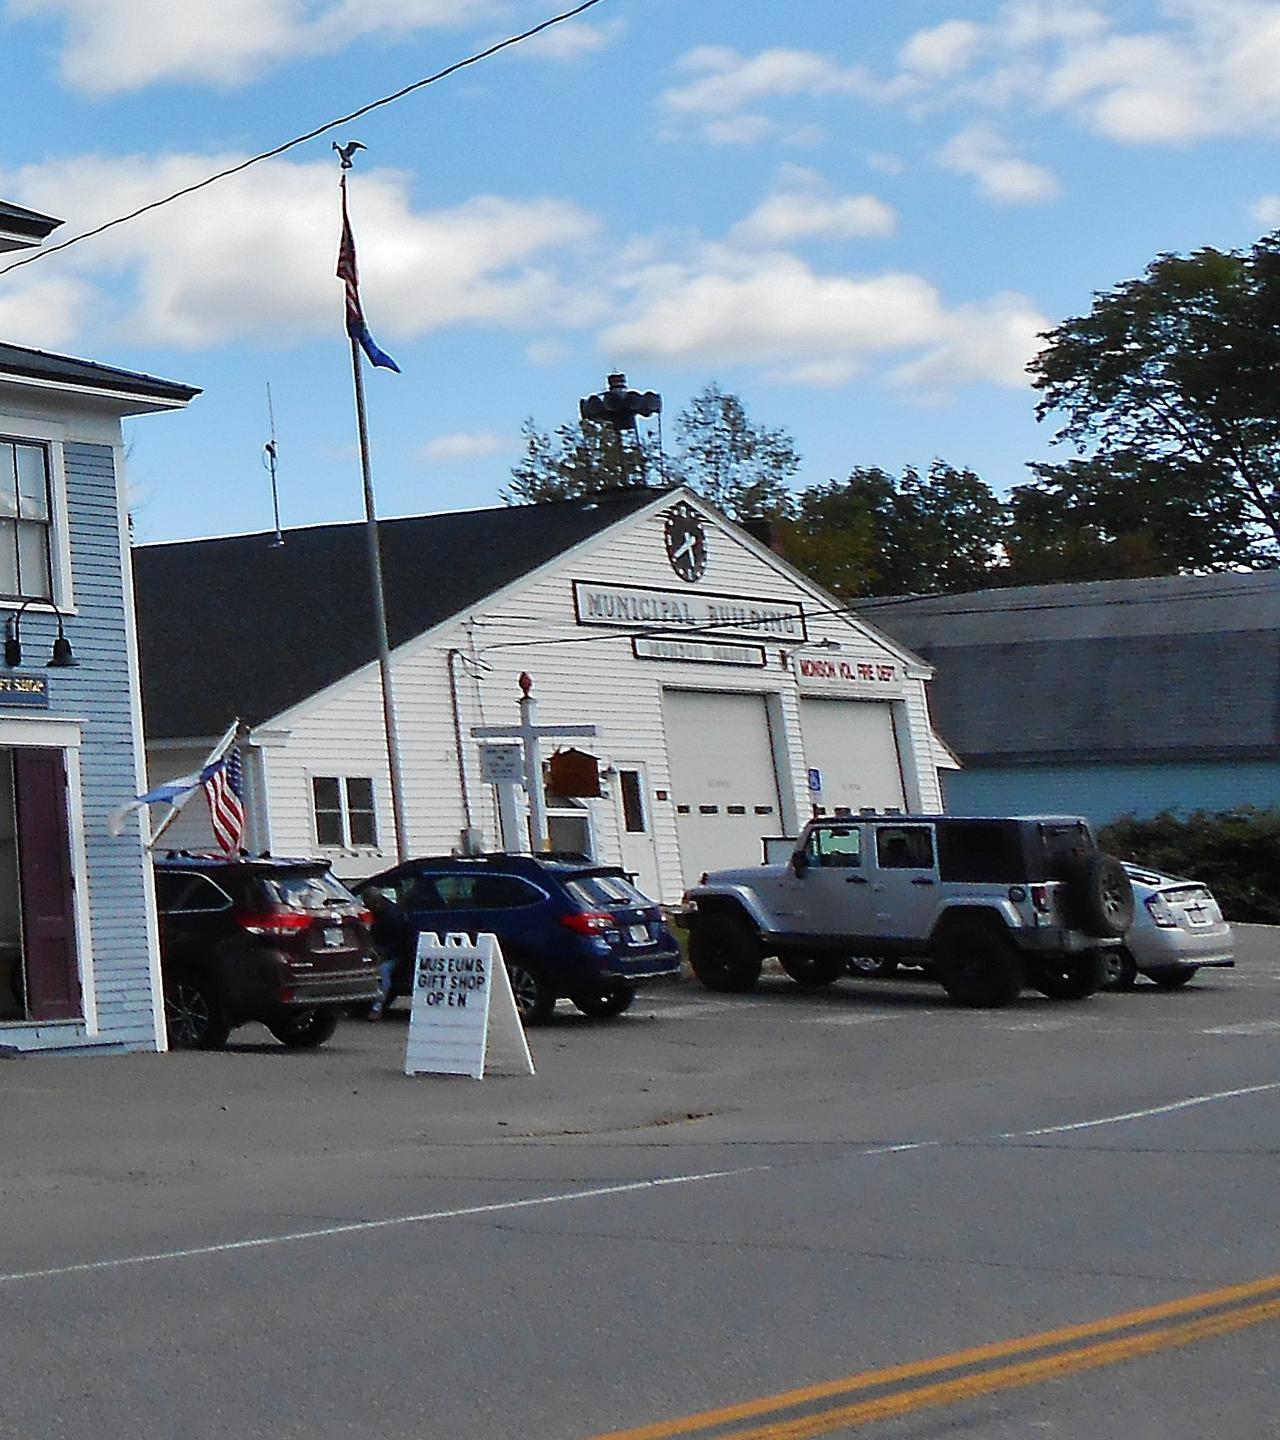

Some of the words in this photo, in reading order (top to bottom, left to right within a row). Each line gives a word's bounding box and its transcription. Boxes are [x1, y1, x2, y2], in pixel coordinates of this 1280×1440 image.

[588, 593, 694, 626] MUNICIPAL
[418, 973, 446, 989] GIFT
[450, 975, 486, 990] SHOP
[426, 991, 467, 1008] OPEN
